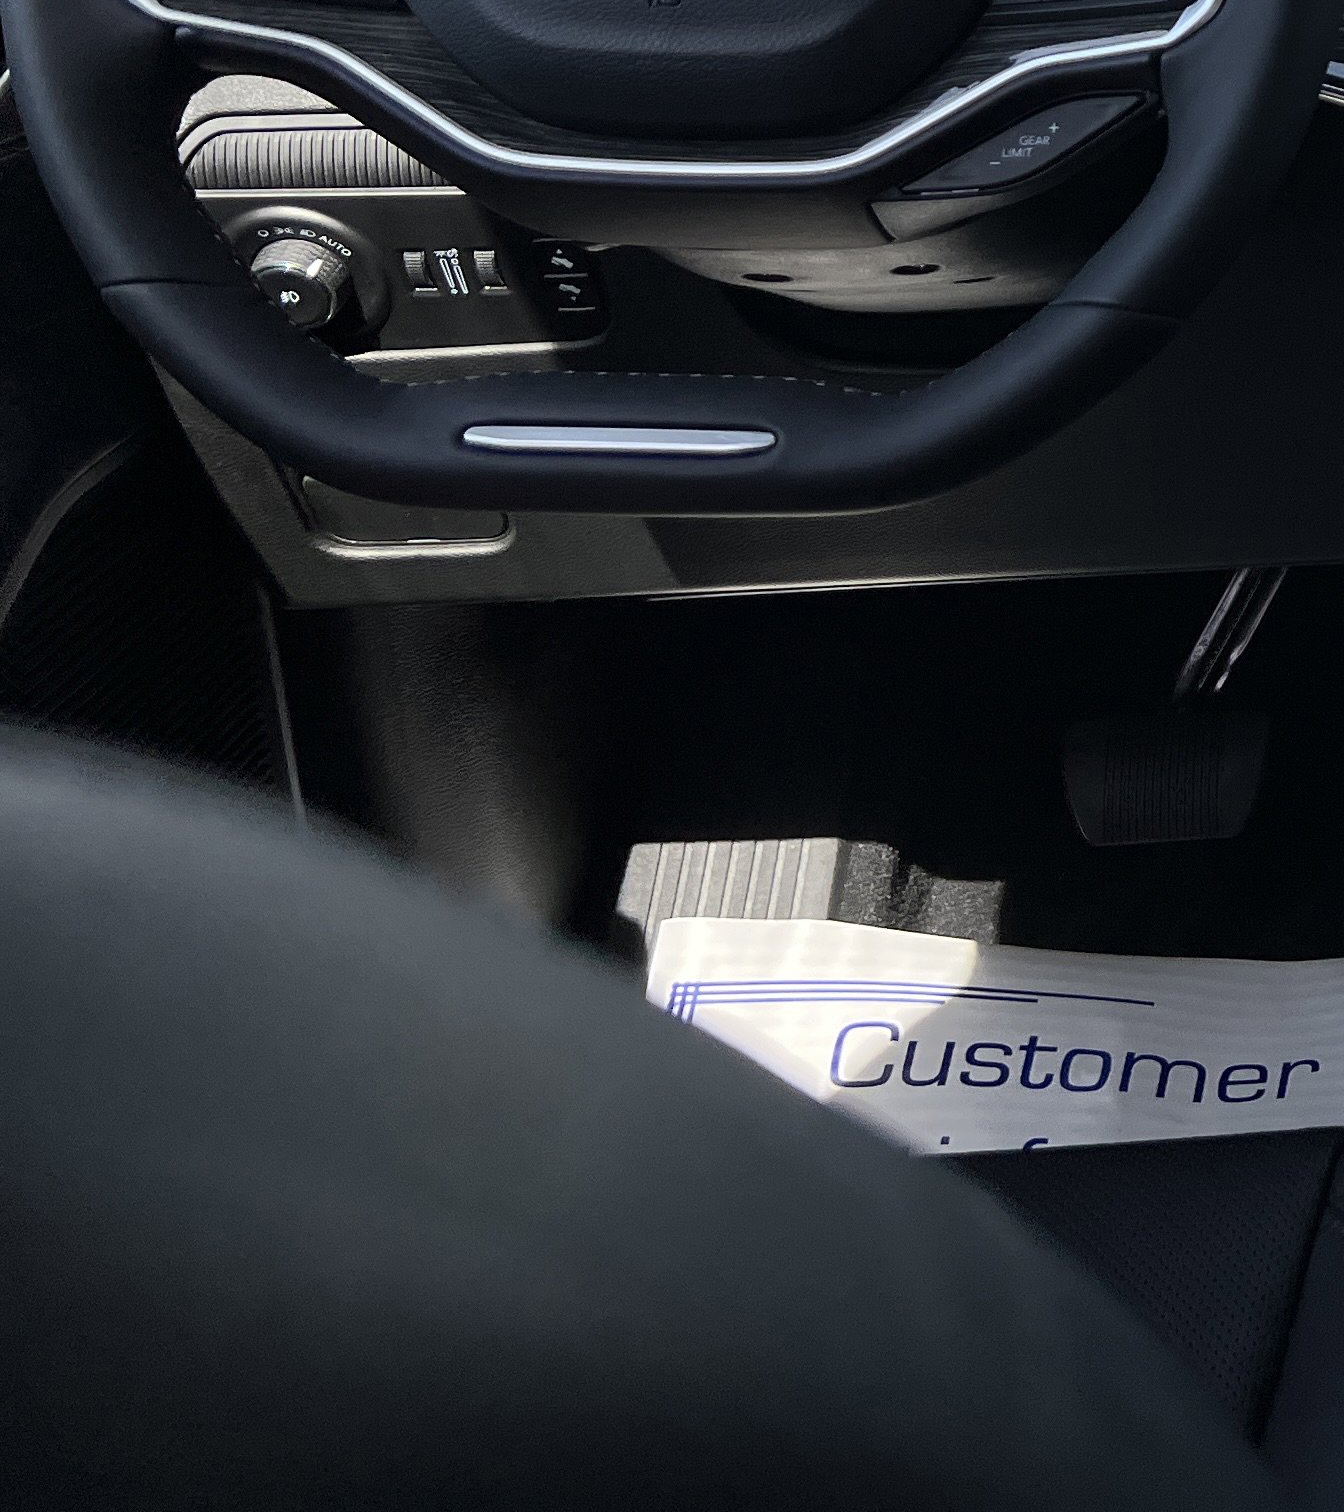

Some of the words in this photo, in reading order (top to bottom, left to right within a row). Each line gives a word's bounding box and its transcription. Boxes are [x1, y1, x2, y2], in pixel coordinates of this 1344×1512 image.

[1019, 135, 1051, 146] GEAR
[1002, 147, 1034, 158] LIMIT
[318, 235, 352, 257] AUTO
[829, 1019, 1321, 1105] Customer
